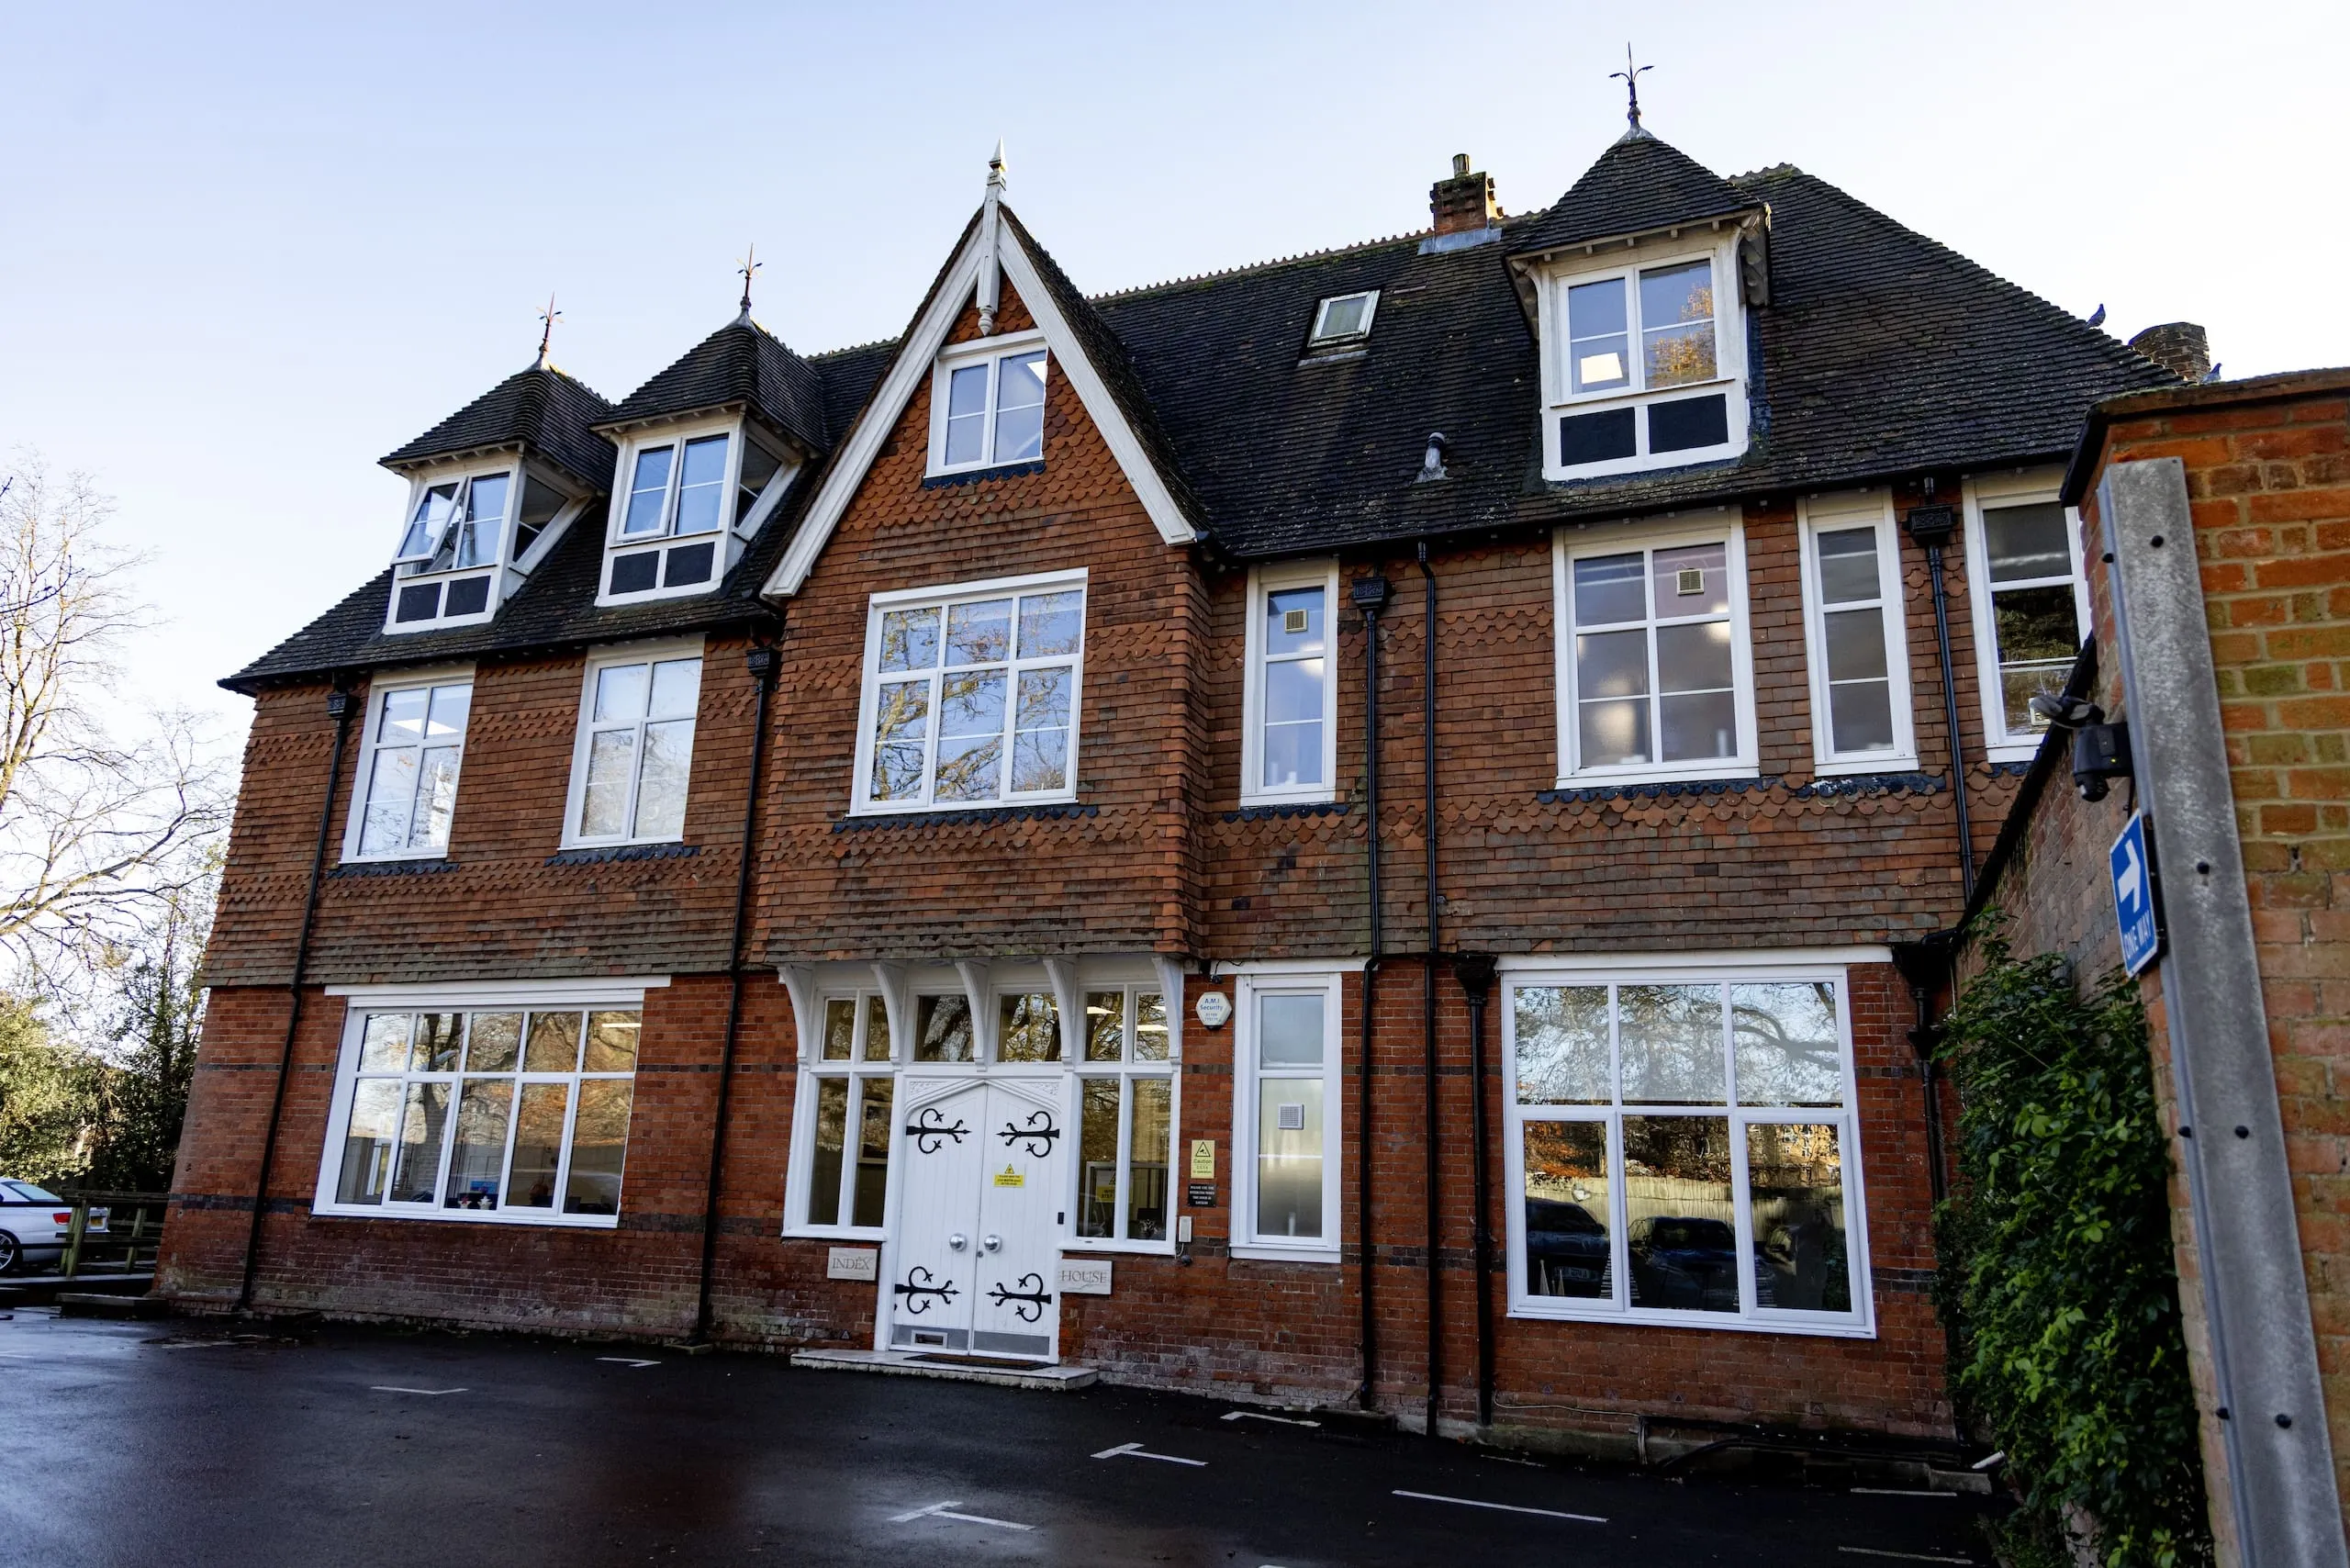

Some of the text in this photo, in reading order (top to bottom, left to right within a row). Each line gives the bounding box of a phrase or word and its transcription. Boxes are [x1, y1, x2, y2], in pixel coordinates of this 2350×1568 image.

[2123, 909, 2152, 960] ONE WAY
[832, 1257, 872, 1271] INDEX
[1061, 1270, 1108, 1283] HOUSE
